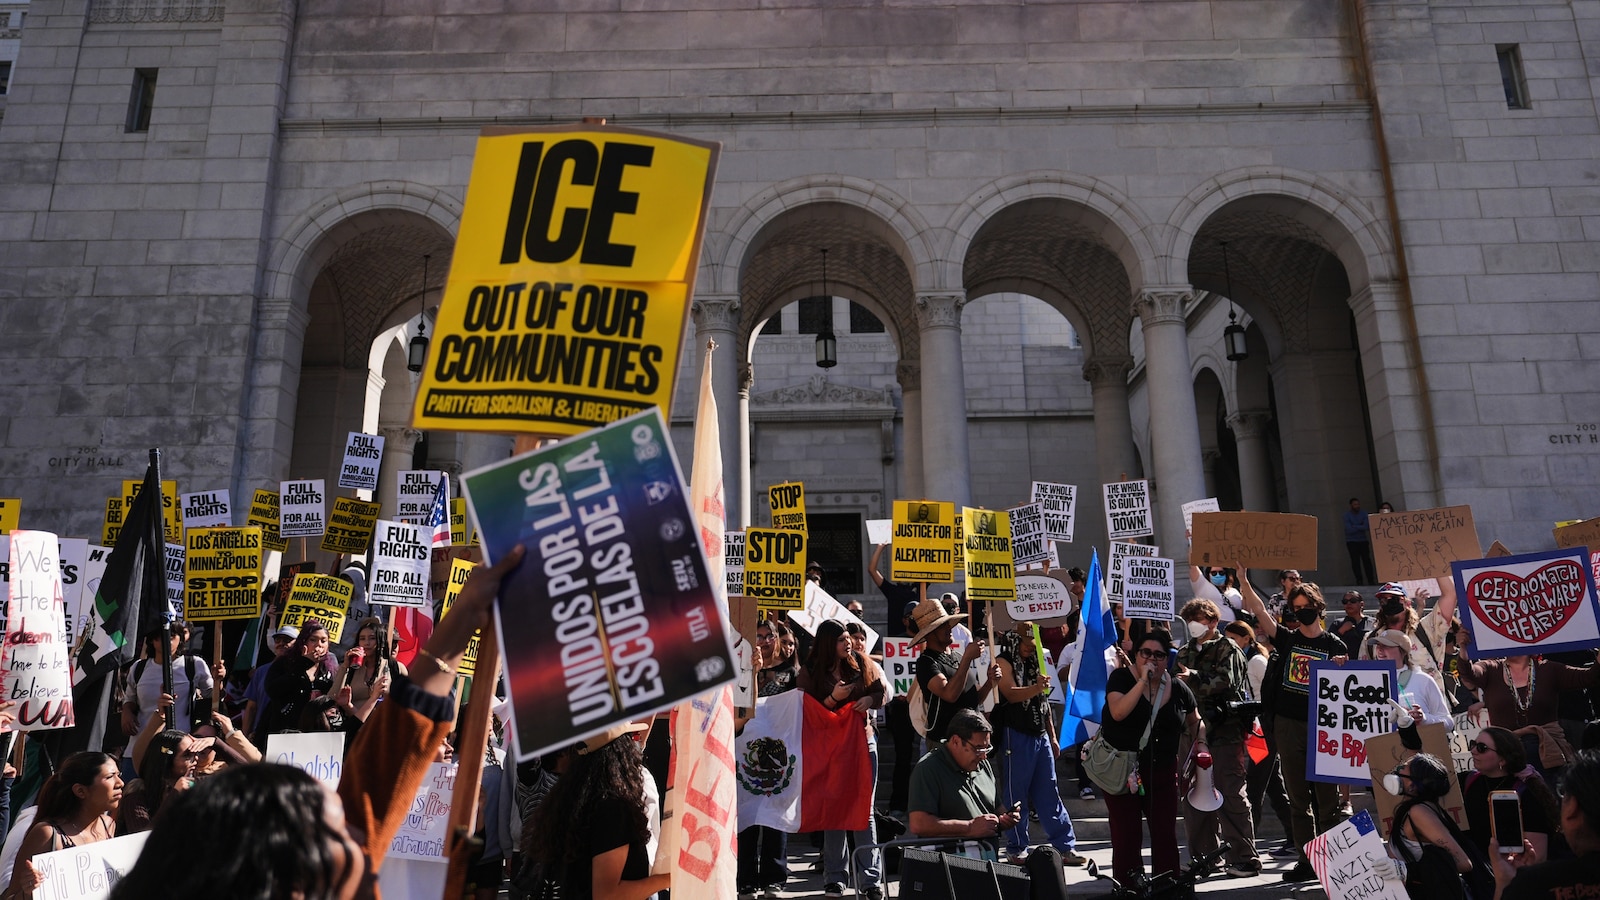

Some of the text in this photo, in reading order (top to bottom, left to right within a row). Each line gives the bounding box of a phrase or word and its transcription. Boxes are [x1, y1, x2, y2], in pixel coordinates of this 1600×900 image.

[500, 139, 655, 267] ICE
[464, 281, 648, 339] OUT OF OUR
[435, 333, 663, 395] COMMUNITIES
[427, 394, 648, 423] PARTY FOR SOCIALISM & LIBERATI
[352, 435, 375, 449] FULL
[1549, 435, 1582, 444] CITY
[346, 445, 380, 460] RIGHTS
[48, 457, 124, 467] CITY HALL
[343, 464, 375, 477] FOR ALL
[341, 474, 375, 483] IMMIGRANTS
[405, 474, 432, 485] FULL
[288, 483, 316, 495] FULL
[400, 484, 437, 496] RIGHTS
[1036, 483, 1072, 496] THE WHOLE
[1107, 482, 1144, 494] THE WHOLE
[189, 494, 220, 506] FULL
[255, 493, 268, 505] LOS
[283, 494, 322, 505] RIGHTS
[770, 485, 801, 510] STOP
[1035, 493, 1073, 501] SYSTEM
[1109, 497, 1145, 510] IS GUILTY
[185, 504, 228, 518] RIGHTS
[251, 507, 280, 519] MINNEAP
[335, 501, 378, 516] LOS ANGELES
[400, 503, 431, 512] FOR AL
[1016, 504, 1039, 519] WHOLE
[1044, 499, 1071, 512] GUILTY
[283, 512, 322, 522] FOR ALL
[331, 514, 374, 528] MINNEAPOLIS
[578, 495, 626, 548] DE
[773, 512, 804, 525] ICE TERROR
[1010, 514, 1041, 525] YSTEM
[1109, 510, 1137, 518] SHUT
[1379, 510, 1455, 529] MAKE ORWELL
[248, 519, 280, 531] STO
[282, 521, 323, 530] IMMIGRANTS
[1014, 520, 1041, 537] GUILTY
[1046, 519, 1068, 534] WN!
[1113, 515, 1147, 531] DOWN!
[1374, 517, 1464, 539] FICTION AGAIN
[328, 526, 370, 537] STOP
[387, 526, 421, 545] FULL
[451, 532, 464, 543] ETTI
[895, 524, 951, 539] JUSTICE FOR
[1202, 521, 1300, 543] ICE OUT OF
[190, 534, 258, 550] LOS ANGELES
[324, 534, 367, 550] ICE TERROR
[748, 531, 803, 564] STOP
[965, 534, 1009, 552] JUSTICE FOR
[1115, 544, 1128, 554] THE
[15, 539, 51, 574] We
[378, 541, 427, 560] RIGHTS
[894, 547, 951, 563] ALEX PRETTI
[1215, 543, 1301, 563] EVERYWHERE
[189, 556, 258, 571] MINNEAPOLIS
[967, 561, 985, 577] ALEX
[985, 563, 1012, 579] PRETTI
[1113, 559, 1121, 571] IS
[1128, 559, 1170, 569] ¡EL PUEBLO
[376, 569, 423, 586] FOR ALL
[671, 559, 691, 591] SEIU
[746, 571, 801, 587] ICE TERROR
[1131, 567, 1166, 579] UNIDO
[188, 576, 258, 590] STOP
[296, 577, 350, 596] LOS ANGELES
[373, 583, 423, 596] IMMIGRANTS
[1474, 577, 1503, 599] ICE
[1521, 577, 1539, 597] NO
[13, 579, 48, 612] the
[188, 589, 257, 608] ICE TERROR
[291, 591, 346, 609] MINNEAPOLIS
[518, 461, 616, 726] UNIDOS POR LAS
[746, 587, 802, 599] NOW!
[1017, 592, 1059, 601] RIME JUST
[1127, 590, 1172, 601] A LAS FAMILIAS
[1029, 600, 1064, 613] EXIST!
[1128, 600, 1170, 610] INMIGRANTES
[1478, 581, 1581, 627] FOR OUR WARM
[283, 614, 300, 625] ICE
[287, 605, 342, 619] STOP
[10, 616, 52, 644] dream
[591, 542, 665, 709] ESCUELAS
[684, 606, 709, 642] UTLA
[1506, 608, 1564, 640] HEARTS
[10, 649, 32, 671] have
[38, 654, 48, 669] to
[11, 676, 60, 700] believe
[1319, 674, 1390, 704] Be Good
[1318, 704, 1389, 733] Be Pretti
[1318, 730, 1338, 755] Be
[1315, 826, 1359, 863] MAKE
[38, 856, 68, 900] Mi
[1329, 851, 1375, 891] NAZIS
[1343, 874, 1385, 900] AFRAID
